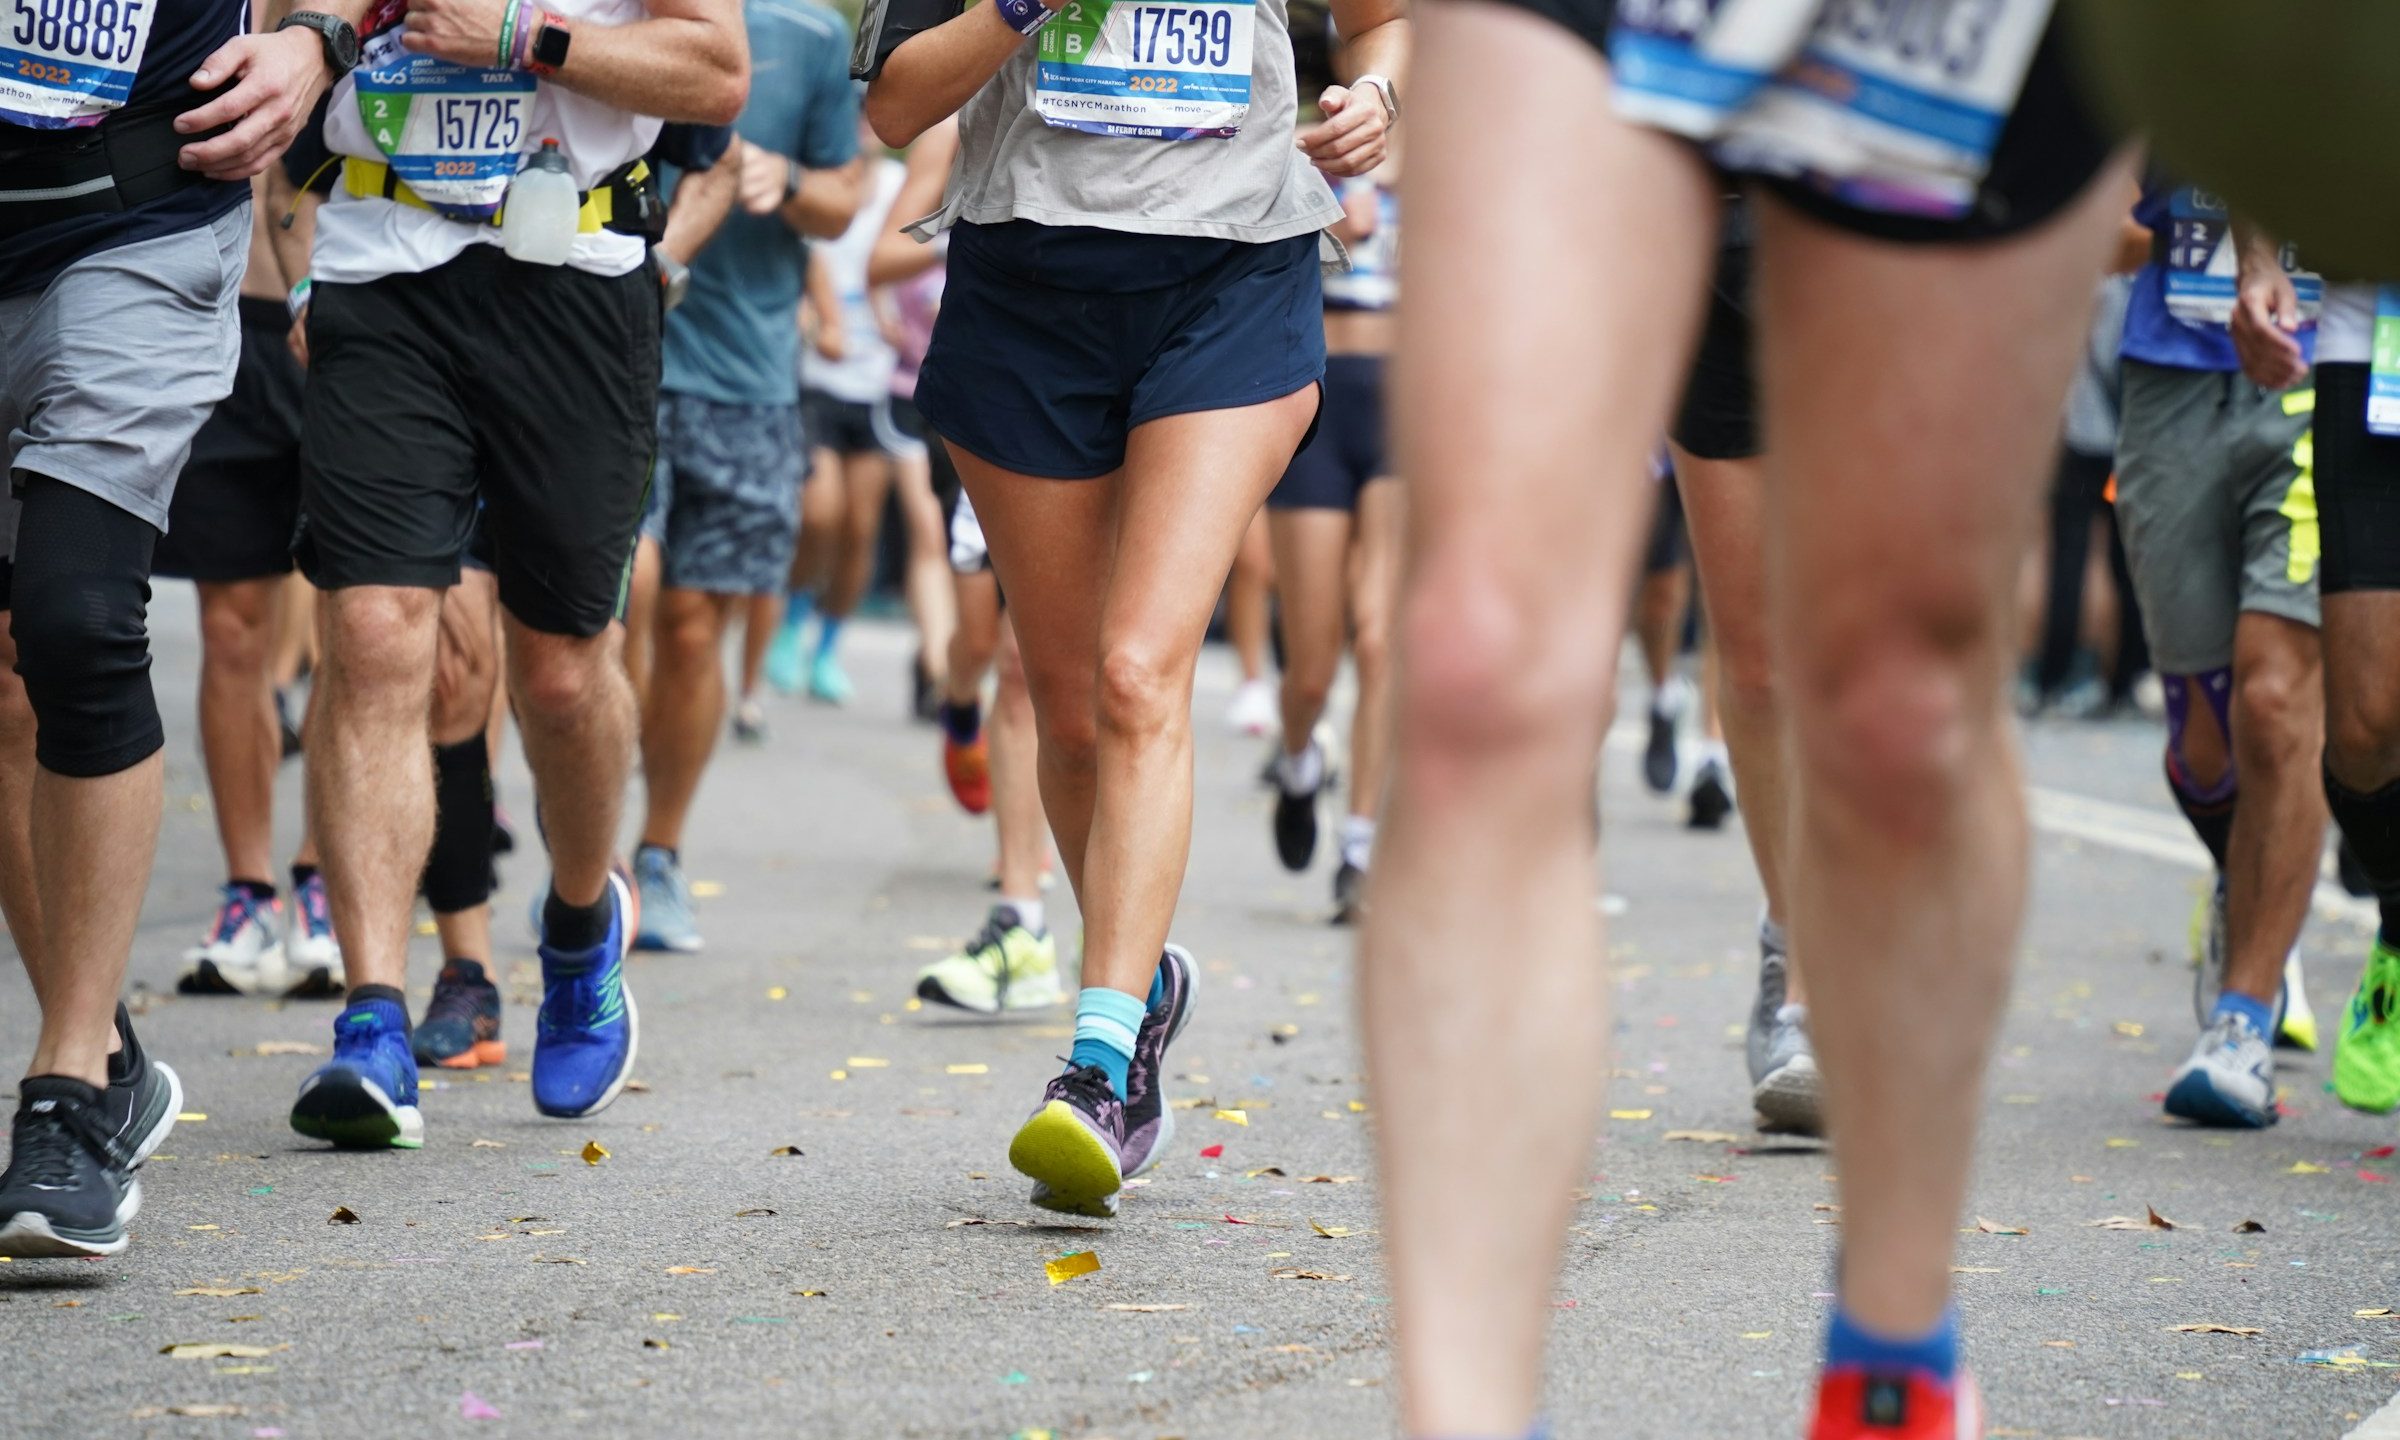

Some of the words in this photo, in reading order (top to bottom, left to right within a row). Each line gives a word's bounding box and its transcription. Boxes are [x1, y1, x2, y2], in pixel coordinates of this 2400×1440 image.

[1068, 2, 1082, 21] 2
[14, 0, 142, 64] 58885
[1133, 7, 1231, 67] 17539
[1065, 33, 1082, 54] B
[18, 59, 71, 85] 2022
[480, 73, 514, 83] TATA
[1129, 75, 1178, 93] 2022
[374, 100, 389, 118] 2
[1042, 98, 1147, 113] #TCSNYCMarathon
[1174, 105, 1201, 113] move
[436, 98, 520, 150] 15725
[1116, 125, 1137, 135] FERRY
[1138, 127, 1162, 136] 6:15AM
[377, 128, 394, 146] A
[434, 161, 477, 177] 2022
[2191, 222, 2208, 241] 2
